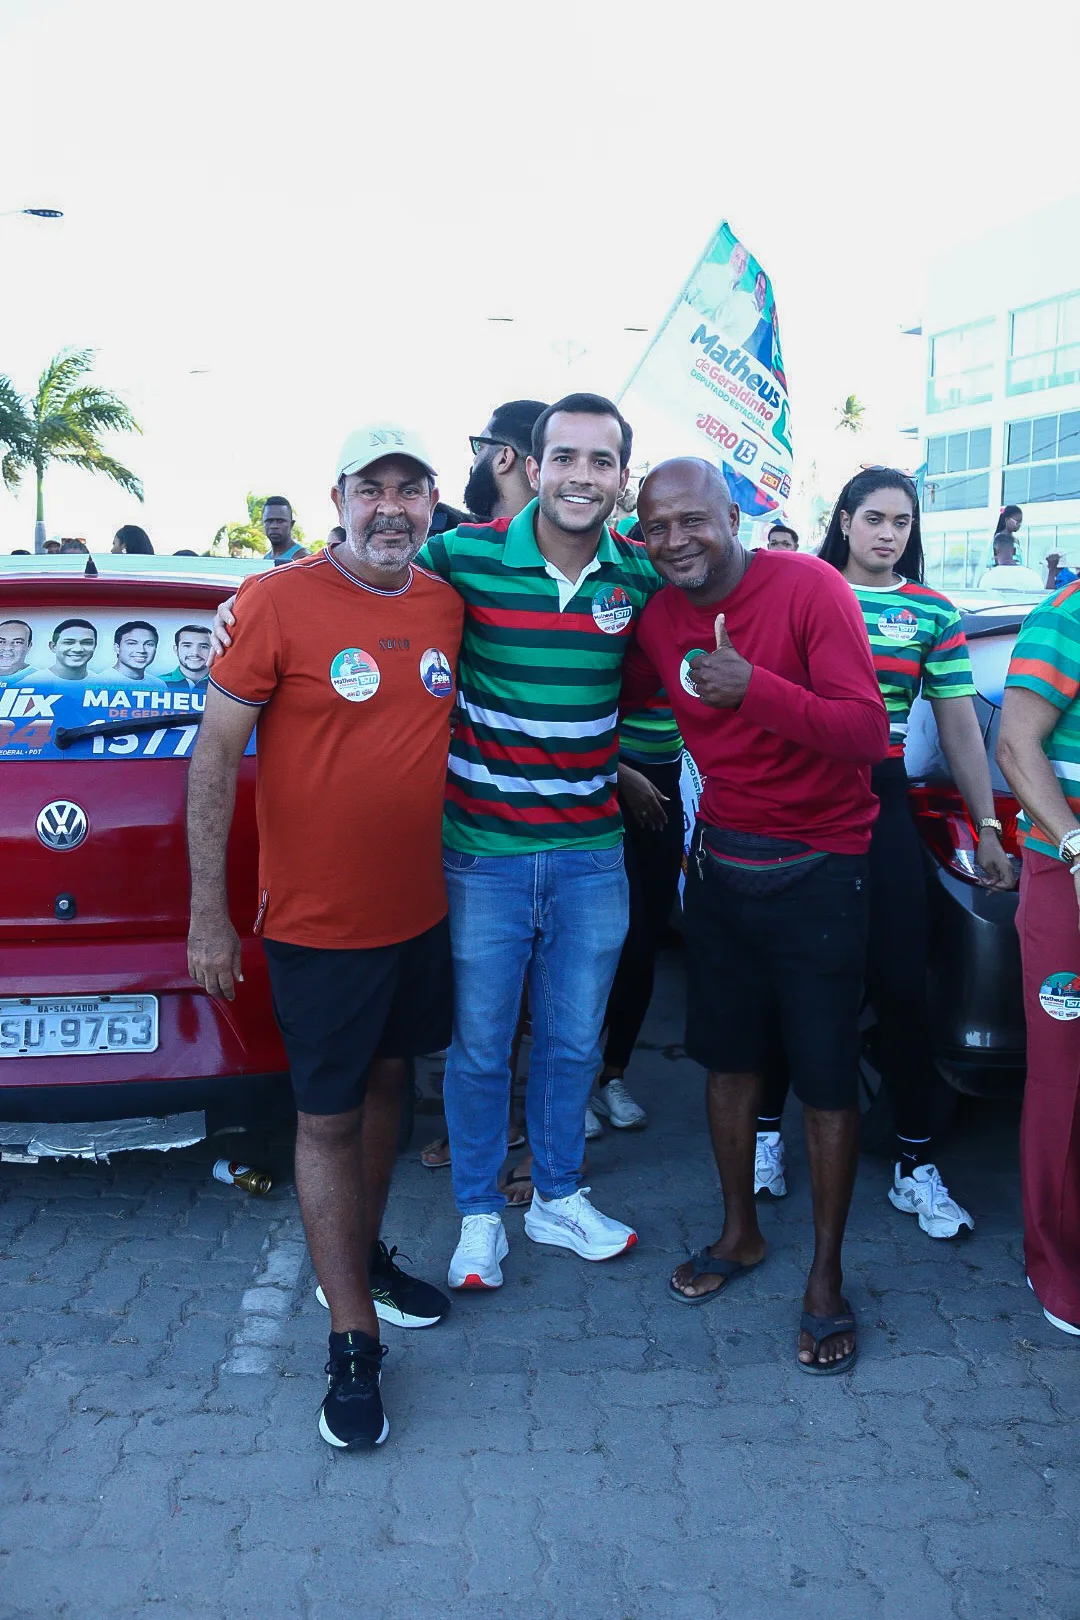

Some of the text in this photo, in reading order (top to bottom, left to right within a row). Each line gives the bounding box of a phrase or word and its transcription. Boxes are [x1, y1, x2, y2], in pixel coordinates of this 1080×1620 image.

[690, 323, 780, 409] Matheus
[695, 358, 774, 421] de Geraldinho
[690, 368, 766, 431] DEPUTADO ESTADUAL
[369, 430, 405, 447] NY
[696, 414, 739, 449] JERO
[737, 441, 757, 463] 13
[83, 689, 206, 711] MATHEU
[109, 709, 128, 718] DE
